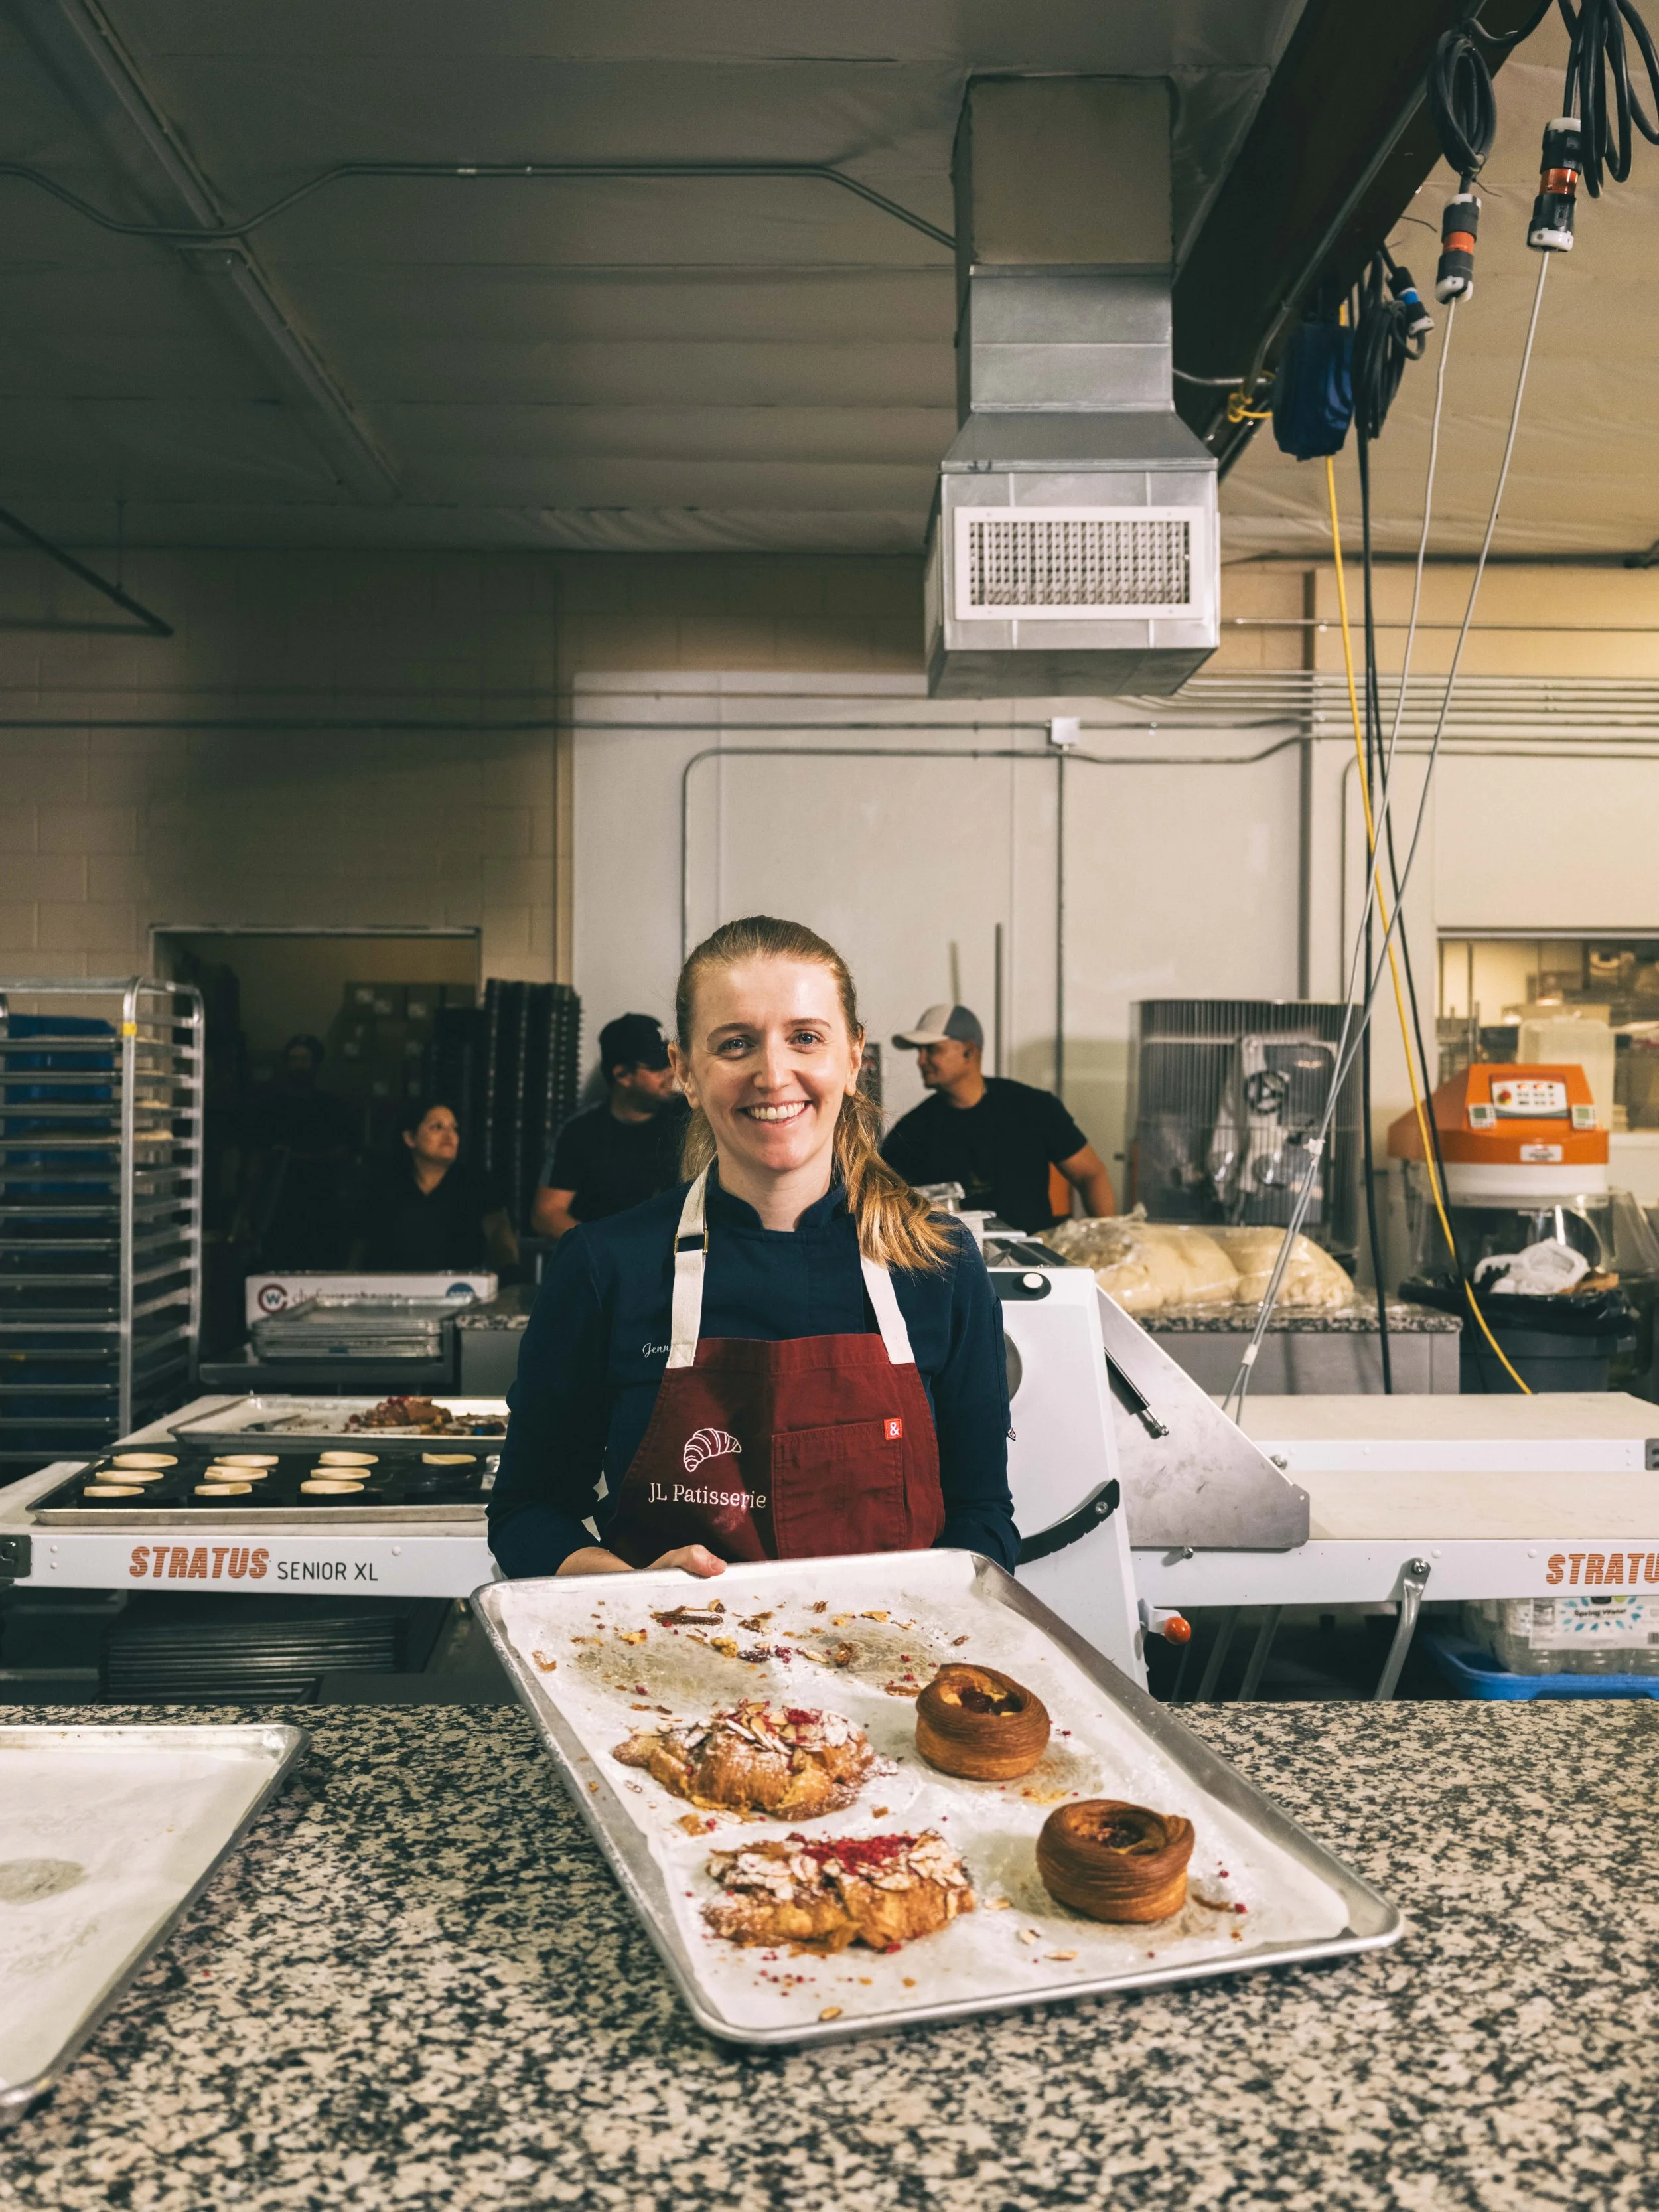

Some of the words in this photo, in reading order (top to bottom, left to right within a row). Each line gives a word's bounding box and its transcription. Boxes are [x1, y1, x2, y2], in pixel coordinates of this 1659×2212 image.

[889, 1422, 899, 1436] &
[648, 1483, 668, 1503] JL
[672, 1483, 766, 1509] Patisserie
[129, 1546, 269, 1579] STRATUS
[277, 1561, 347, 1581] SENIOR
[354, 1562, 379, 1581] XL
